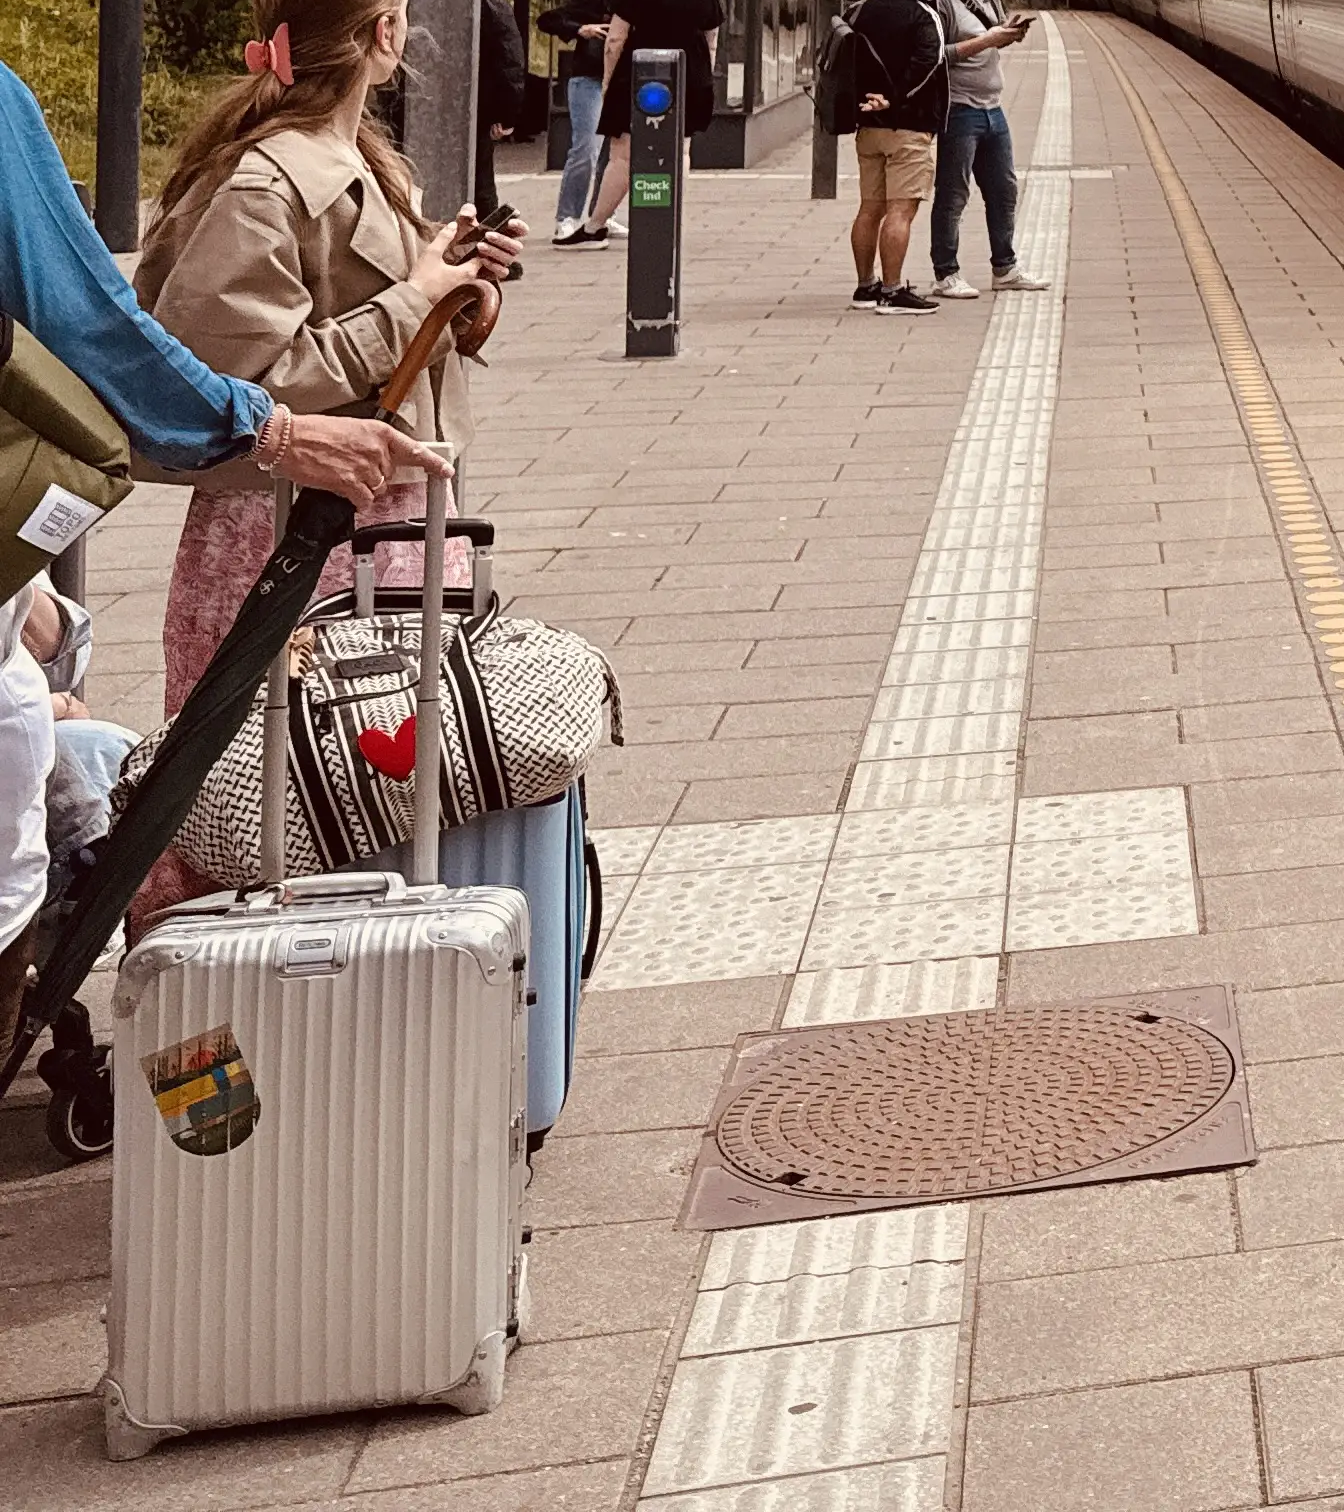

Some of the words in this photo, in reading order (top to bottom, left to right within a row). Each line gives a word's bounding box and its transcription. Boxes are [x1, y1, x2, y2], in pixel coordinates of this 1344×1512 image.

[634, 180, 669, 190] Check
[643, 191, 661, 200] ind
[55, 512, 82, 539] TOPO
